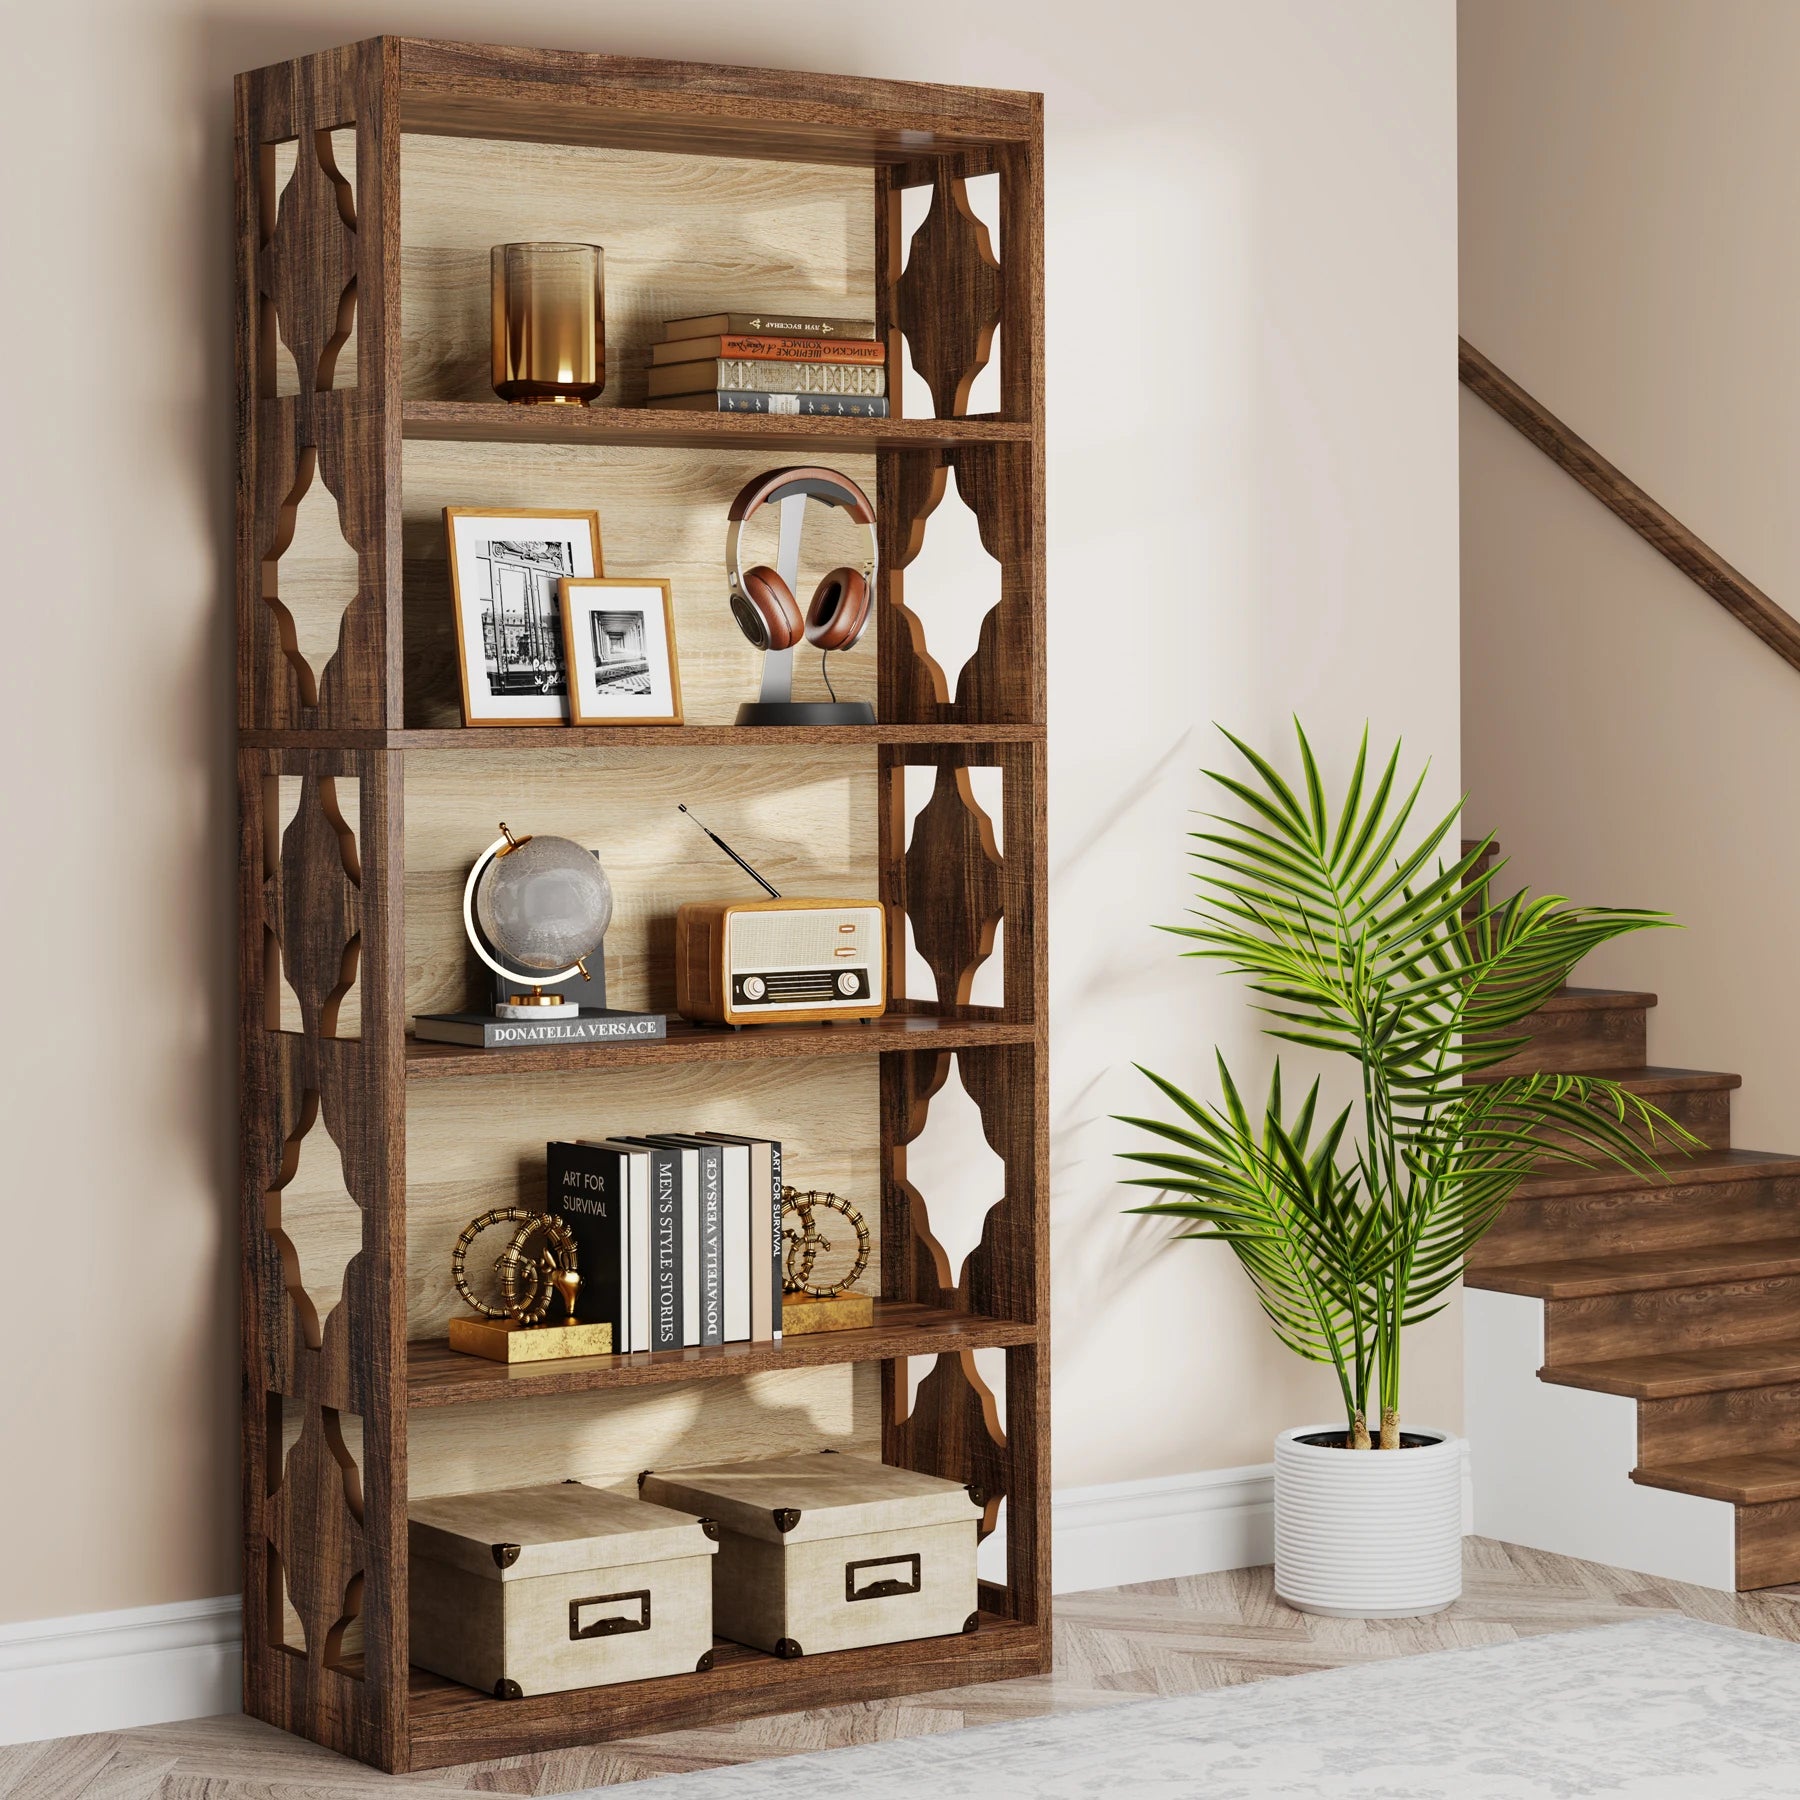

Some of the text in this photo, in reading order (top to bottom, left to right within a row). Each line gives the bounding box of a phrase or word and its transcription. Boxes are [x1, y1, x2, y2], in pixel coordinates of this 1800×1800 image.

[776, 347, 822, 358] ШЕРЛОКЕ
[781, 339, 822, 349] ХОЛМСЕ
[823, 346, 879, 357] ЗАПИСКИ О
[494, 1021, 656, 1041] DONATELLA VERSACE
[562, 1170, 605, 1192] ART FOR
[563, 1195, 607, 1217] SURVIVAL
[772, 1150, 782, 1257] ART FOR SURVIVAL
[659, 1162, 674, 1342] MEN'S STYLE STORIES
[706, 1158, 718, 1336] DONATELLA VERSACE
